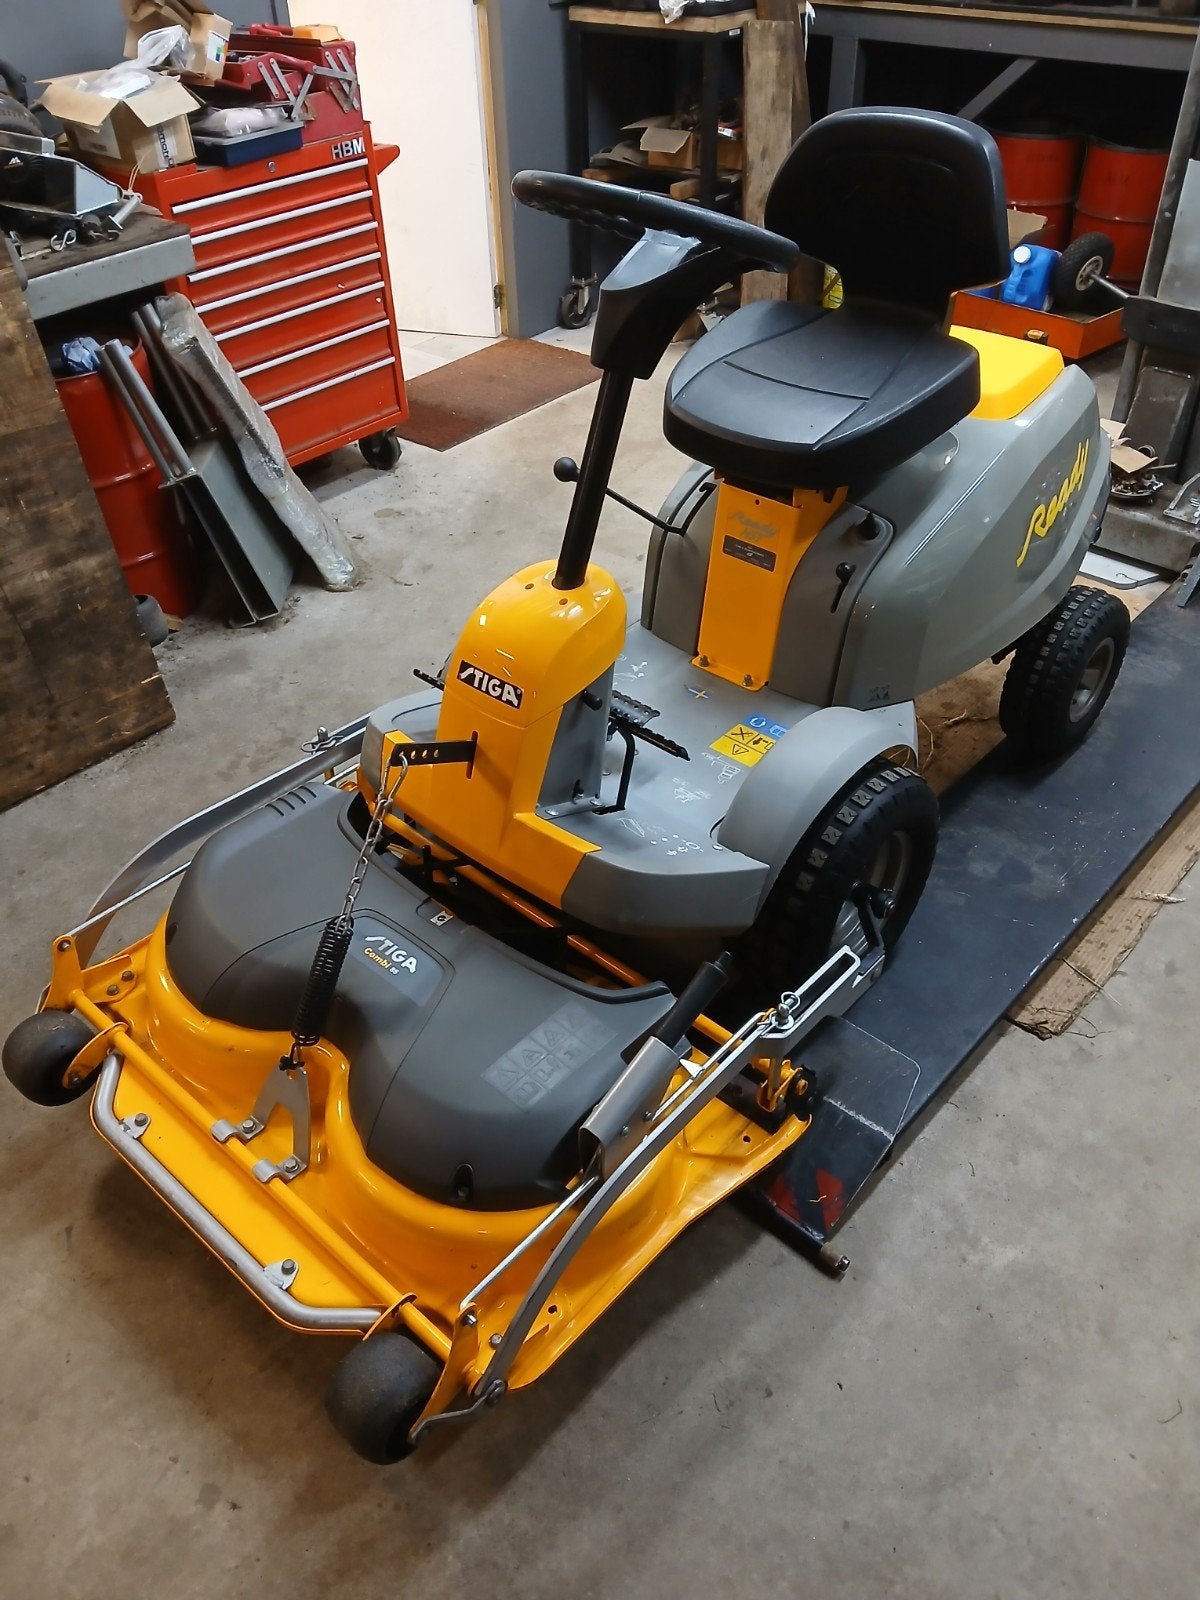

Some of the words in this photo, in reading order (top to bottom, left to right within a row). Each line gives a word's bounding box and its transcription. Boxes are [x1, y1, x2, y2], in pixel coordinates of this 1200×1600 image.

[331, 136, 366, 160] HBM
[1016, 438, 1089, 567] Ready
[460, 667, 519, 707] STIGA
[363, 947, 392, 969] Combi
[364, 936, 417, 973] STIGA
